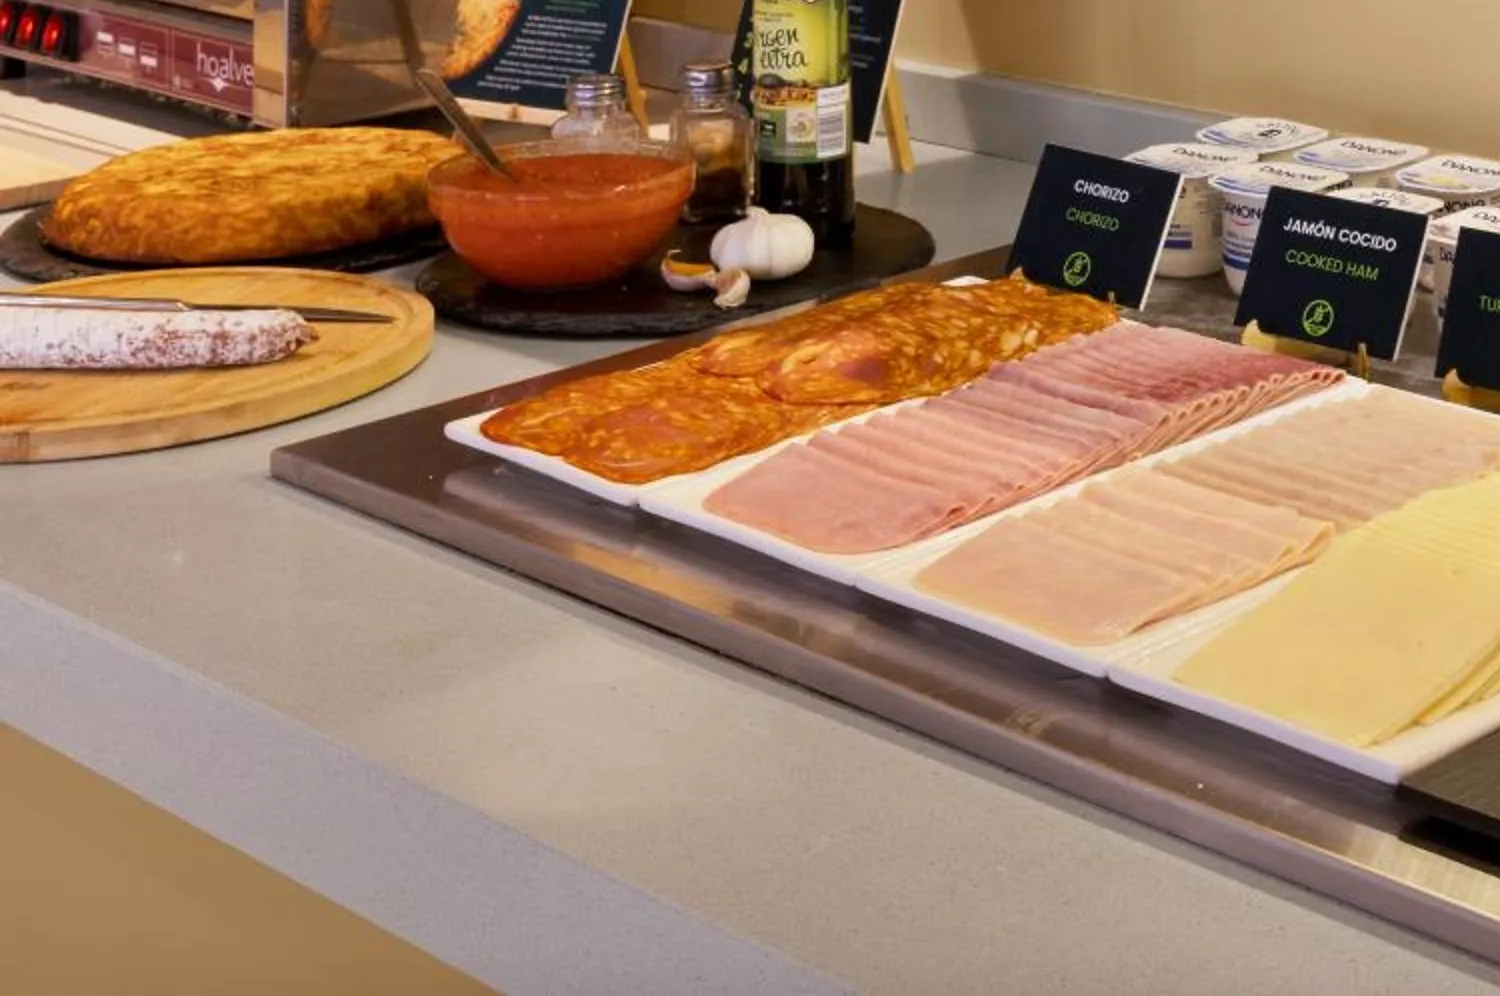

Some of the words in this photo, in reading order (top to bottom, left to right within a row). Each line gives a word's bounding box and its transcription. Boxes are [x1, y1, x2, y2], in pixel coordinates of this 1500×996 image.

[1073, 179, 1130, 203] CHORIZO
[1065, 207, 1119, 231] CHORIZO
[1283, 217, 1337, 241] JAMÓN
[1338, 229, 1398, 252] COCIDO
[1285, 249, 1343, 274] COOKED
[1345, 261, 1380, 281] HAM
